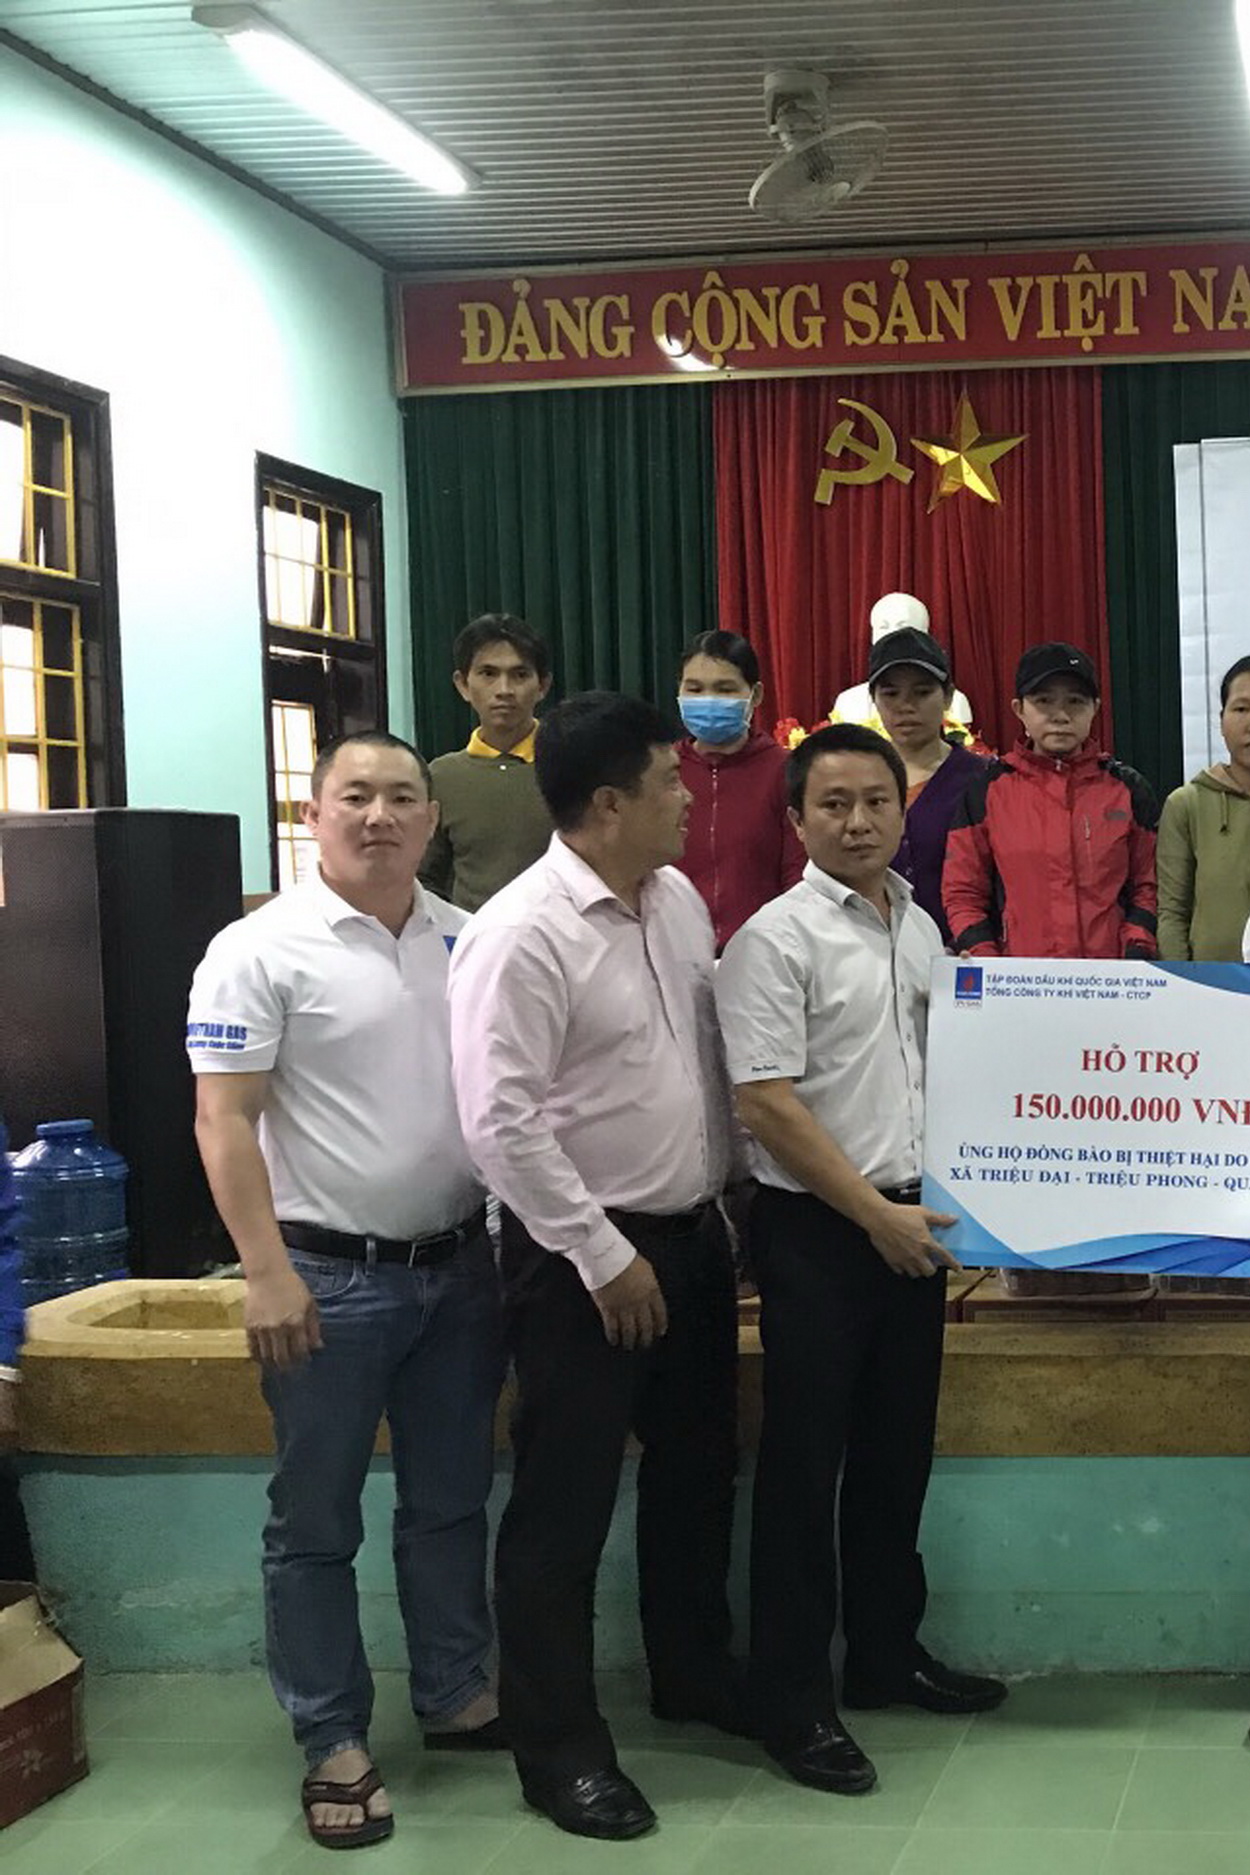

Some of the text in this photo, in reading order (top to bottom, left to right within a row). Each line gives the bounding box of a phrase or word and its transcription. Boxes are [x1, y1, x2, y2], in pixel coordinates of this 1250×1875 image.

[460, 277, 634, 365] ĐẢNG
[651, 270, 827, 369] CỘNG
[843, 259, 970, 345] SẢN
[987, 253, 1147, 353] VIỆT
[1081, 1043, 1200, 1081] HỖ TRỢ
[1012, 1092, 1182, 1123] 150.000.000
[1136, 1149, 1187, 1167] THIỆT
[1189, 1151, 1220, 1169] HẠI
[1223, 1153, 1249, 1167] DO
[950, 1165, 973, 1181] XÃ
[978, 1166, 1034, 1184] TRIỆU
[1039, 1170, 1071, 1186] ĐẠI
[1085, 1170, 1141, 1188] TRIỆU
[1146, 1173, 1208, 1188] PHONG
